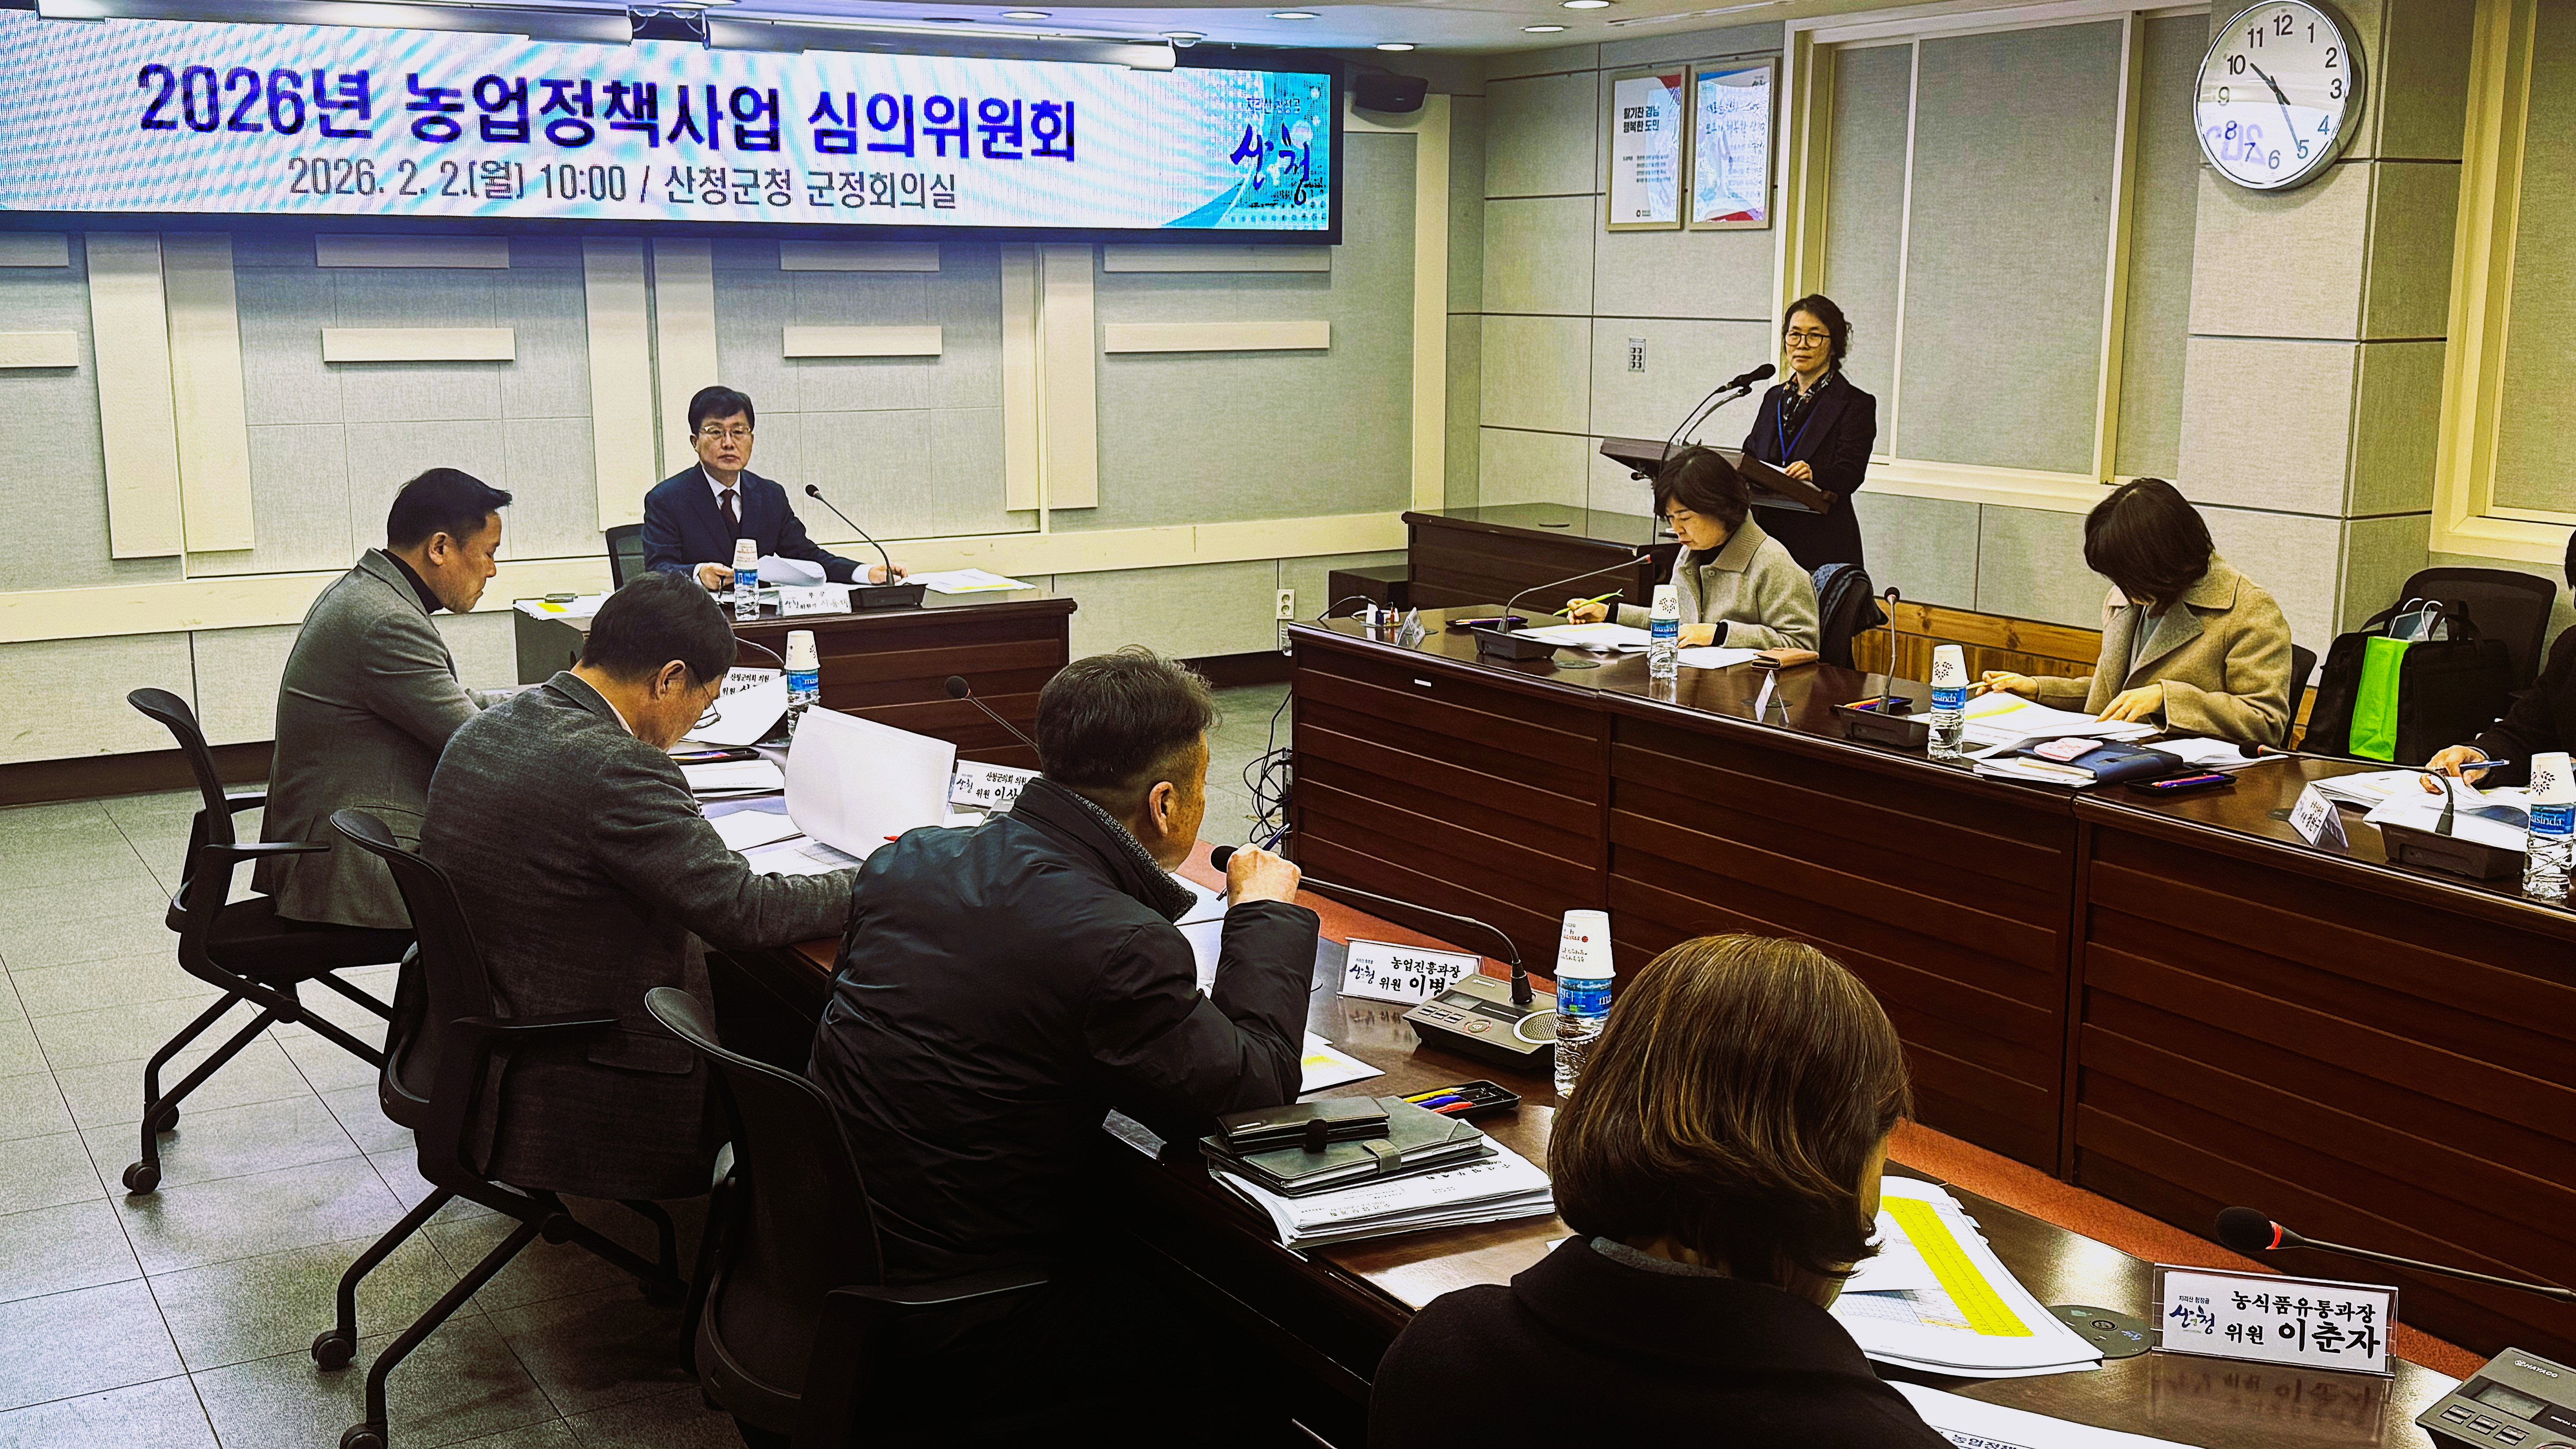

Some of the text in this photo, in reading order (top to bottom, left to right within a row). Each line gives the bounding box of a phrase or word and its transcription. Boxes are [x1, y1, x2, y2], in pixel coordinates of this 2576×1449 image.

[2273, 14, 2293, 36] 12
[2308, 22, 2314, 43] 1
[2247, 27, 2263, 48] 11
[2227, 55, 2246, 75] 10
[2325, 47, 2337, 68] 2
[2218, 86, 2230, 106] 9
[2330, 78, 2342, 99] 3
[138, 63, 1076, 162] 2026년 농업정책사업 심의위원회
[1624, 105, 1660, 120] 활기찬 경남
[1624, 120, 1659, 133] 행복한 도민
[2225, 120, 2237, 140] 8
[2317, 115, 2330, 135] 4
[2244, 142, 2256, 162] 7
[2268, 149, 2281, 170] 6
[2296, 139, 2309, 159] 5
[289, 156, 384, 196] 2026.
[398, 158, 428, 196] 2.
[541, 163, 626, 202] 10:00
[640, 165, 650, 204] /
[664, 167, 794, 207] 산청군청
[807, 170, 957, 211] 군정회의실
[986, 772, 1013, 784] 산청군의회
[975, 788, 990, 799] 위원
[1391, 957, 1461, 979] 농업진흥과장
[1379, 977, 1401, 991] 위원
[1409, 974, 1457, 997] 이병
[2231, 1291, 2376, 1324] 농식품유통과장
[2224, 1318, 2381, 1359] 위원 이춘자
